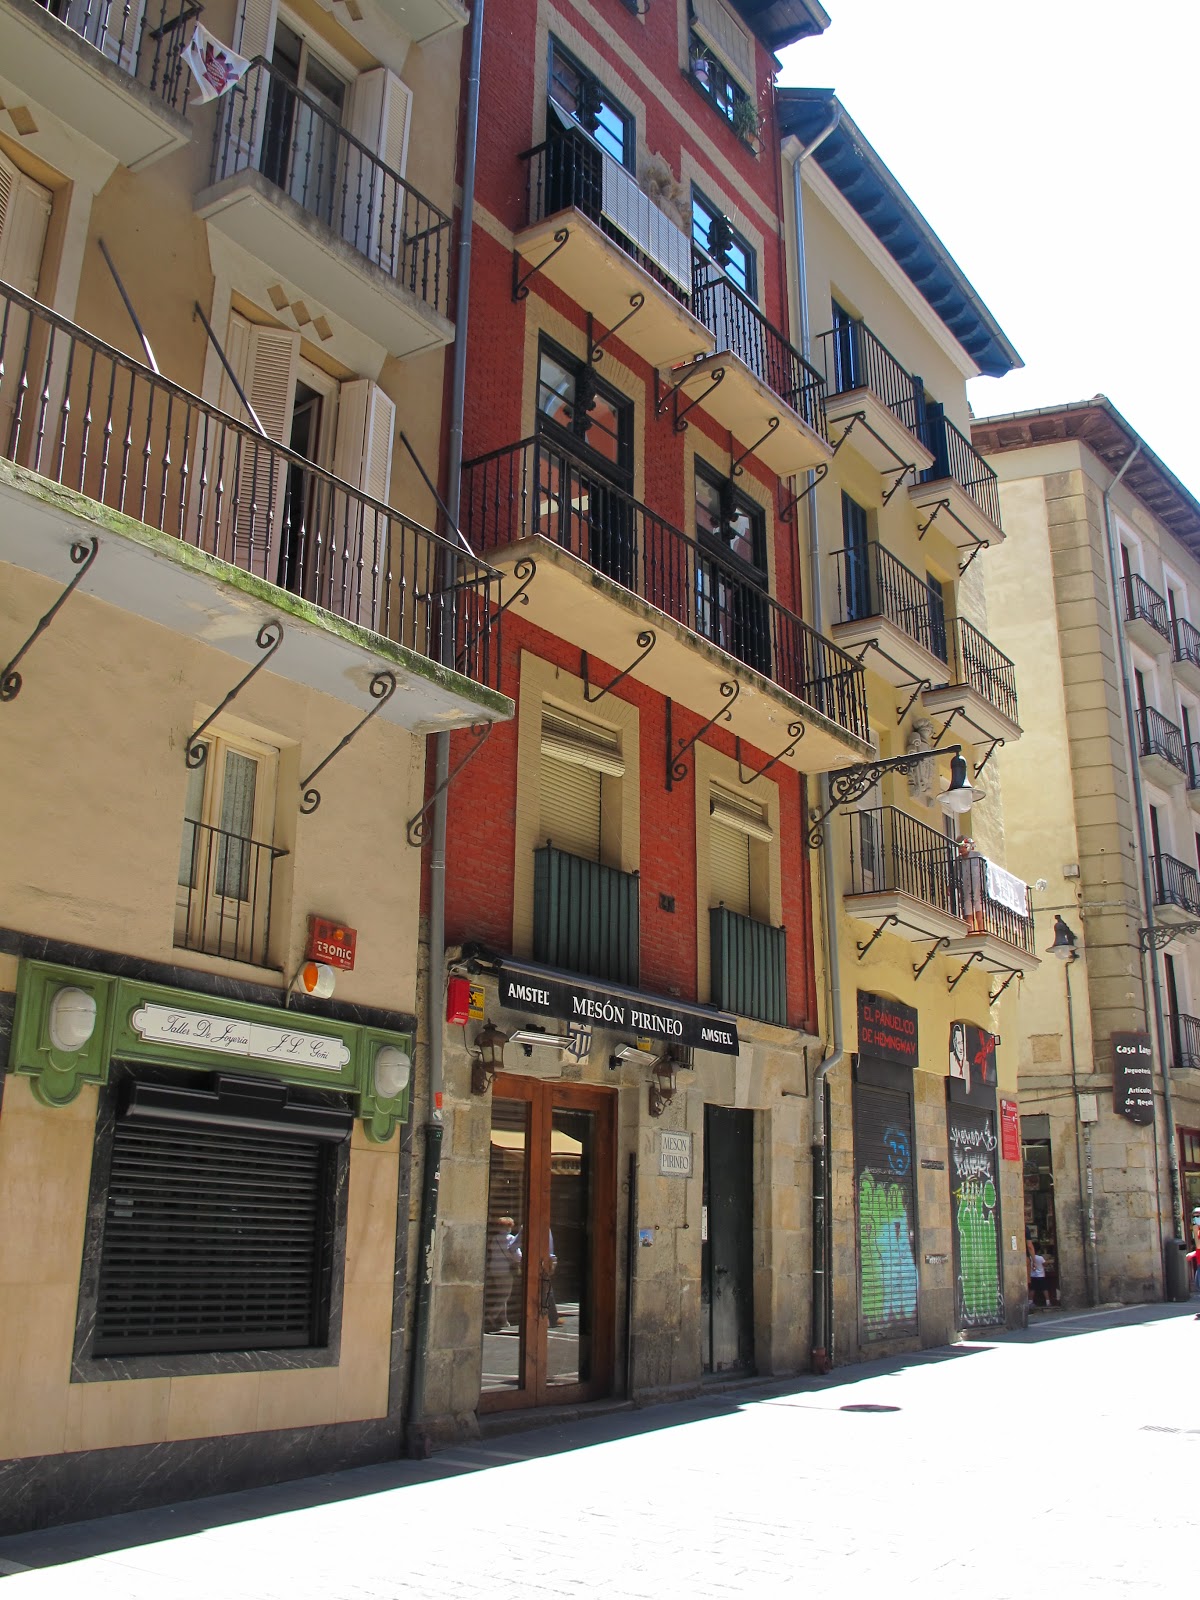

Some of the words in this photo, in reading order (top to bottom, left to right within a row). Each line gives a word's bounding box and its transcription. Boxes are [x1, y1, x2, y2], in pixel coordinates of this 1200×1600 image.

[507, 982, 550, 1006] AMSTEL
[572, 996, 625, 1025] MESÓN
[630, 1009, 683, 1037] PIRINEO
[863, 1006, 874, 1022] EL
[161, 1014, 190, 1036] Taller
[193, 1019, 211, 1039] De
[309, 1039, 329, 1060] Goñi
[701, 1027, 733, 1046] AMSTEL
[862, 1027, 873, 1043] DE
[1116, 1045, 1136, 1055] Casa
[1125, 1098, 1135, 1106] de
[662, 1153, 689, 1170] PIRINEO
